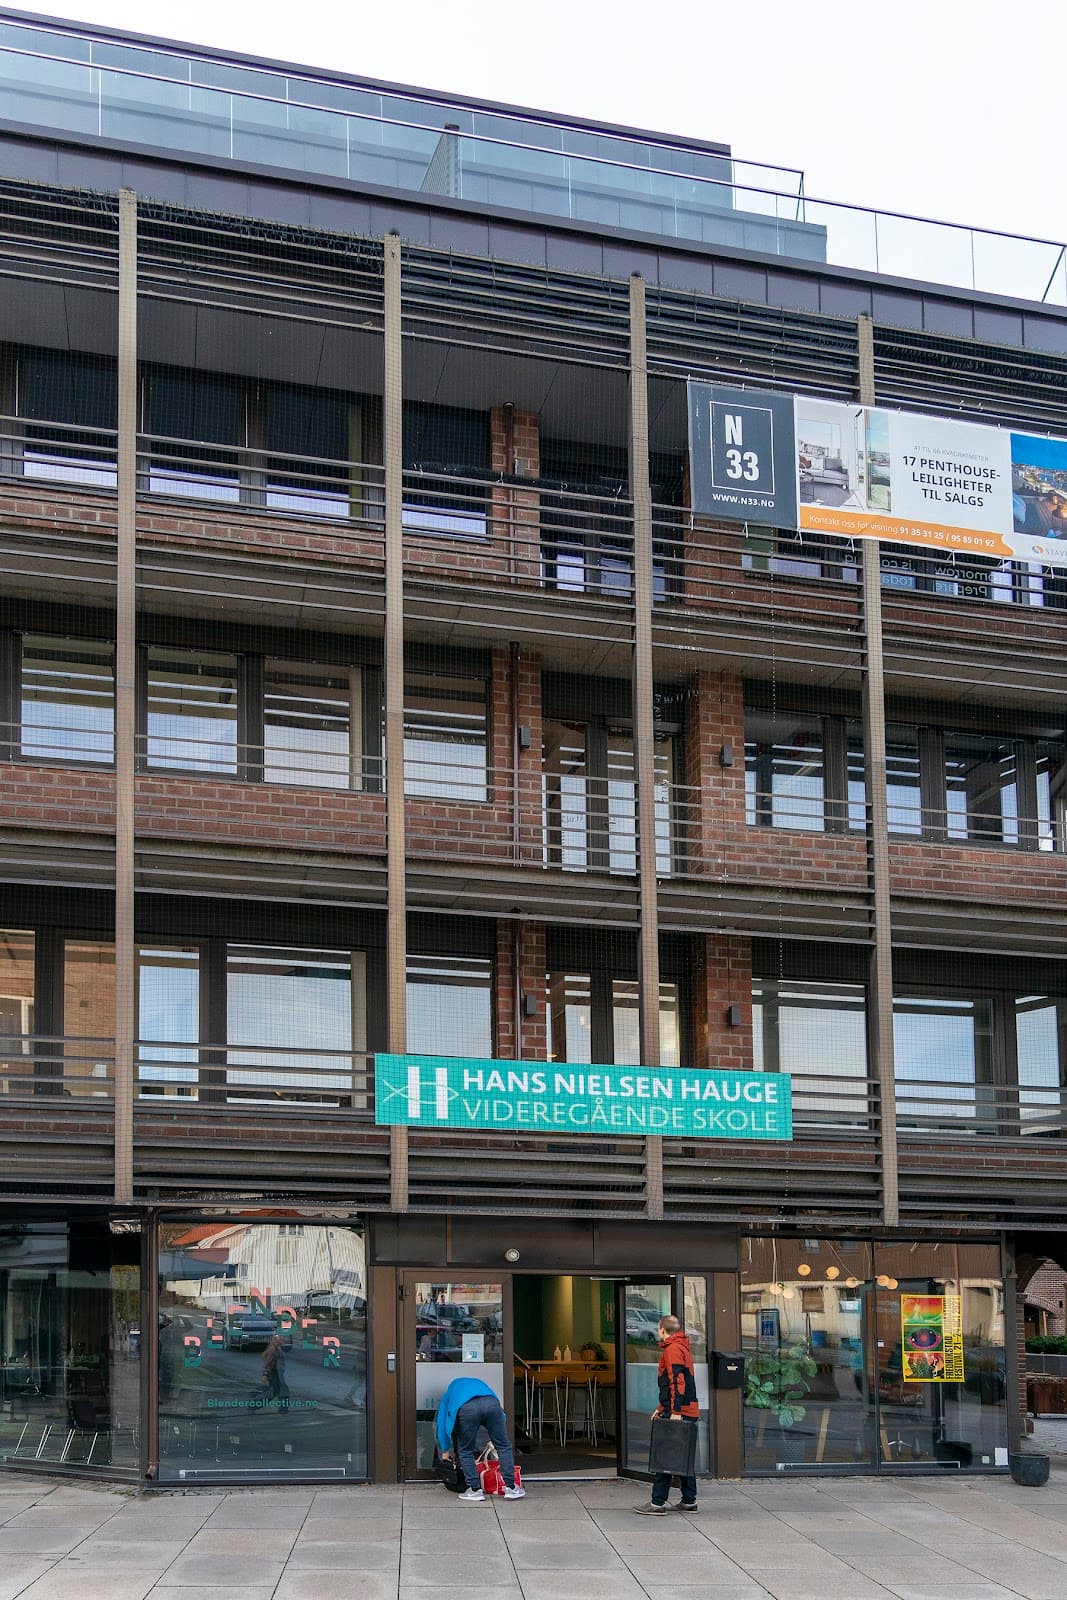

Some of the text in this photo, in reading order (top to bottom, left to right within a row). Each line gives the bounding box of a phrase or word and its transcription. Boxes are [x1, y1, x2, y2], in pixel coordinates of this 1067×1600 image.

[724, 414, 743, 446] N
[726, 449, 760, 481] 33
[902, 456, 1001, 479] 17 PENTHOUSE-
[912, 472, 992, 493] LEILIGHETER
[712, 493, 775, 508] WWW.N33.NO
[921, 488, 984, 507] TIL SALGS
[809, 514, 839, 526] Kontakt
[842, 521, 855, 529] oss
[857, 521, 868, 529] for
[870, 523, 898, 534] visning
[900, 526, 909, 535] 91
[911, 528, 921, 536] 35
[922, 530, 932, 538] 31
[934, 531, 944, 540] 25
[951, 535, 961, 543] 95
[974, 537, 983, 546] 01
[985, 538, 995, 548] 92
[463, 1069, 778, 1104] HANS NIELSEN HAUGE
[462, 1098, 778, 1132] VIDEREGÅENDE SKOLE
[207, 1398, 320, 1408] Blendercollective.no
